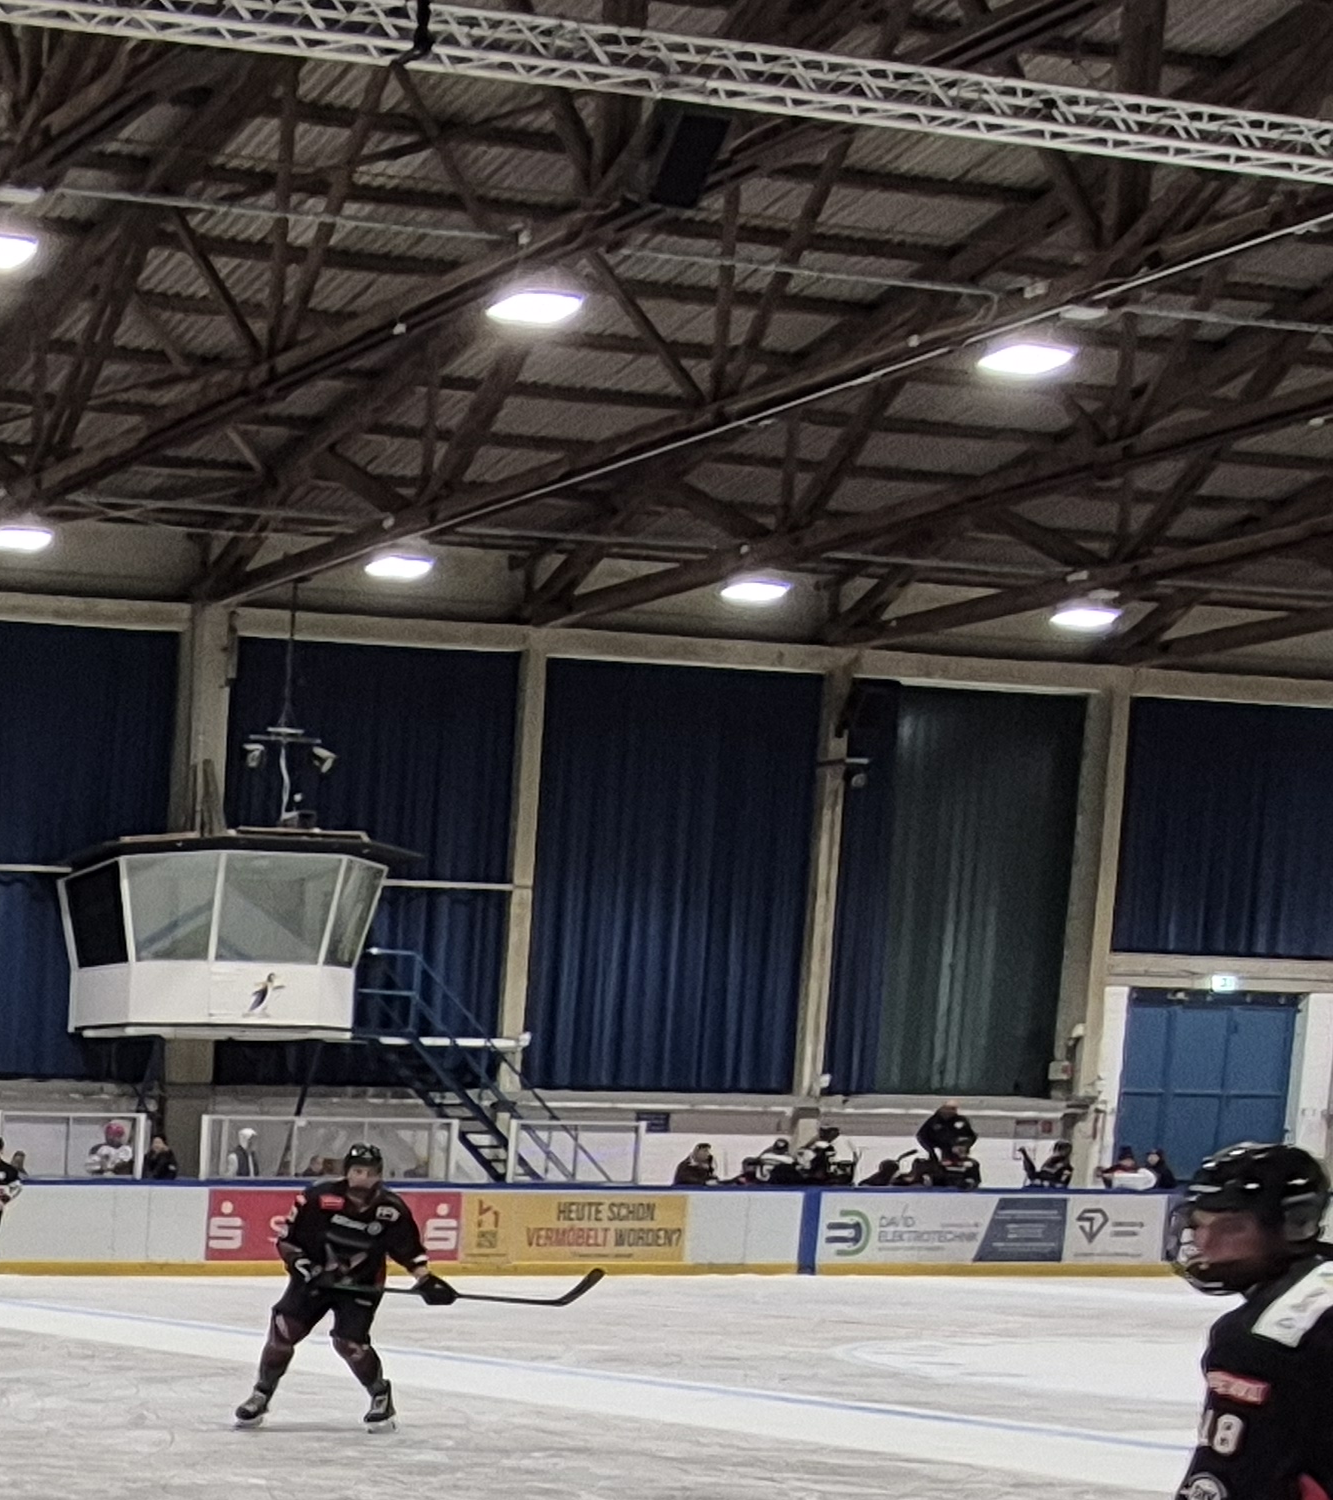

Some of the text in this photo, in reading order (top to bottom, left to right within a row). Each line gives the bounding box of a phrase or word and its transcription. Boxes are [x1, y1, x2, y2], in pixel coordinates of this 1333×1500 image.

[556, 1201, 657, 1222] HEUTE SCHON
[614, 1227, 683, 1248] WORDEN?
